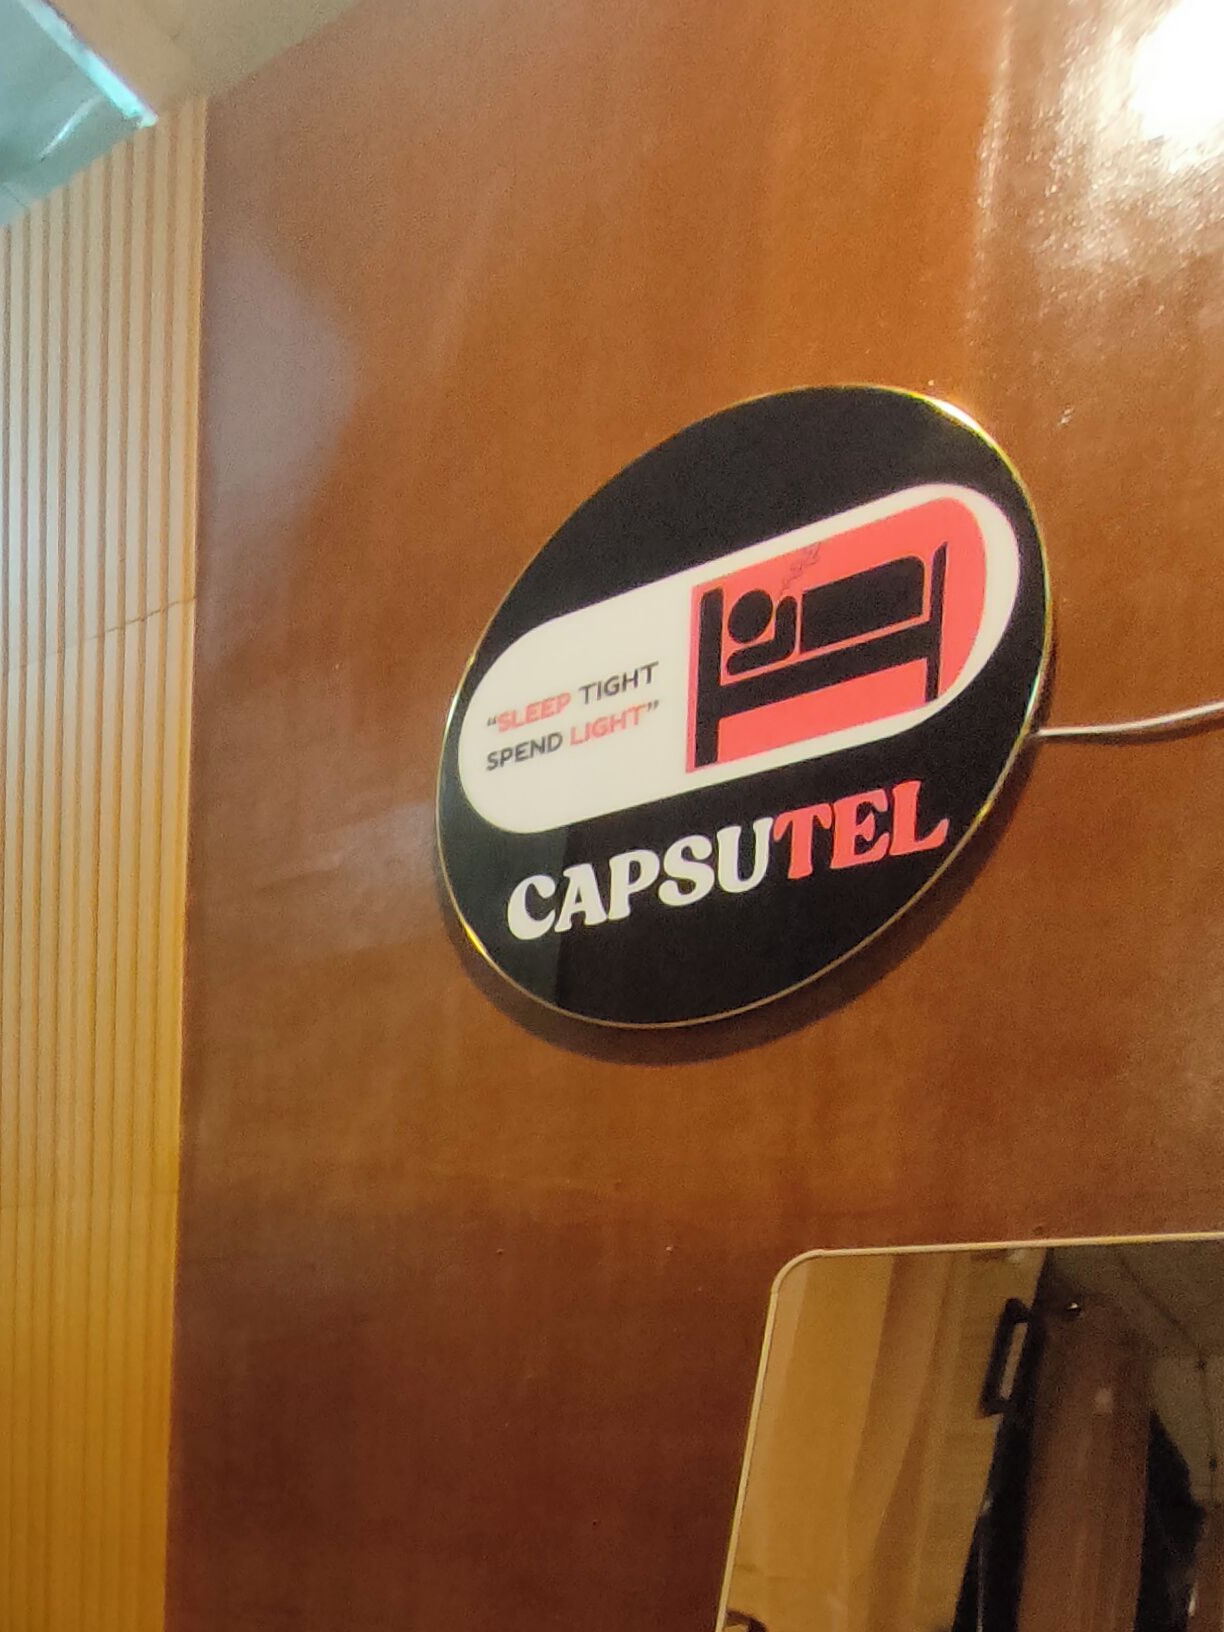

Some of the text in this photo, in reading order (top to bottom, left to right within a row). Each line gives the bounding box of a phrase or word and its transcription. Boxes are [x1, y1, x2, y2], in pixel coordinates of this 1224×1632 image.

[579, 660, 660, 705] TIGHT
[486, 731, 564, 771] SPEND
[507, 780, 950, 940] CAPSUTEL
